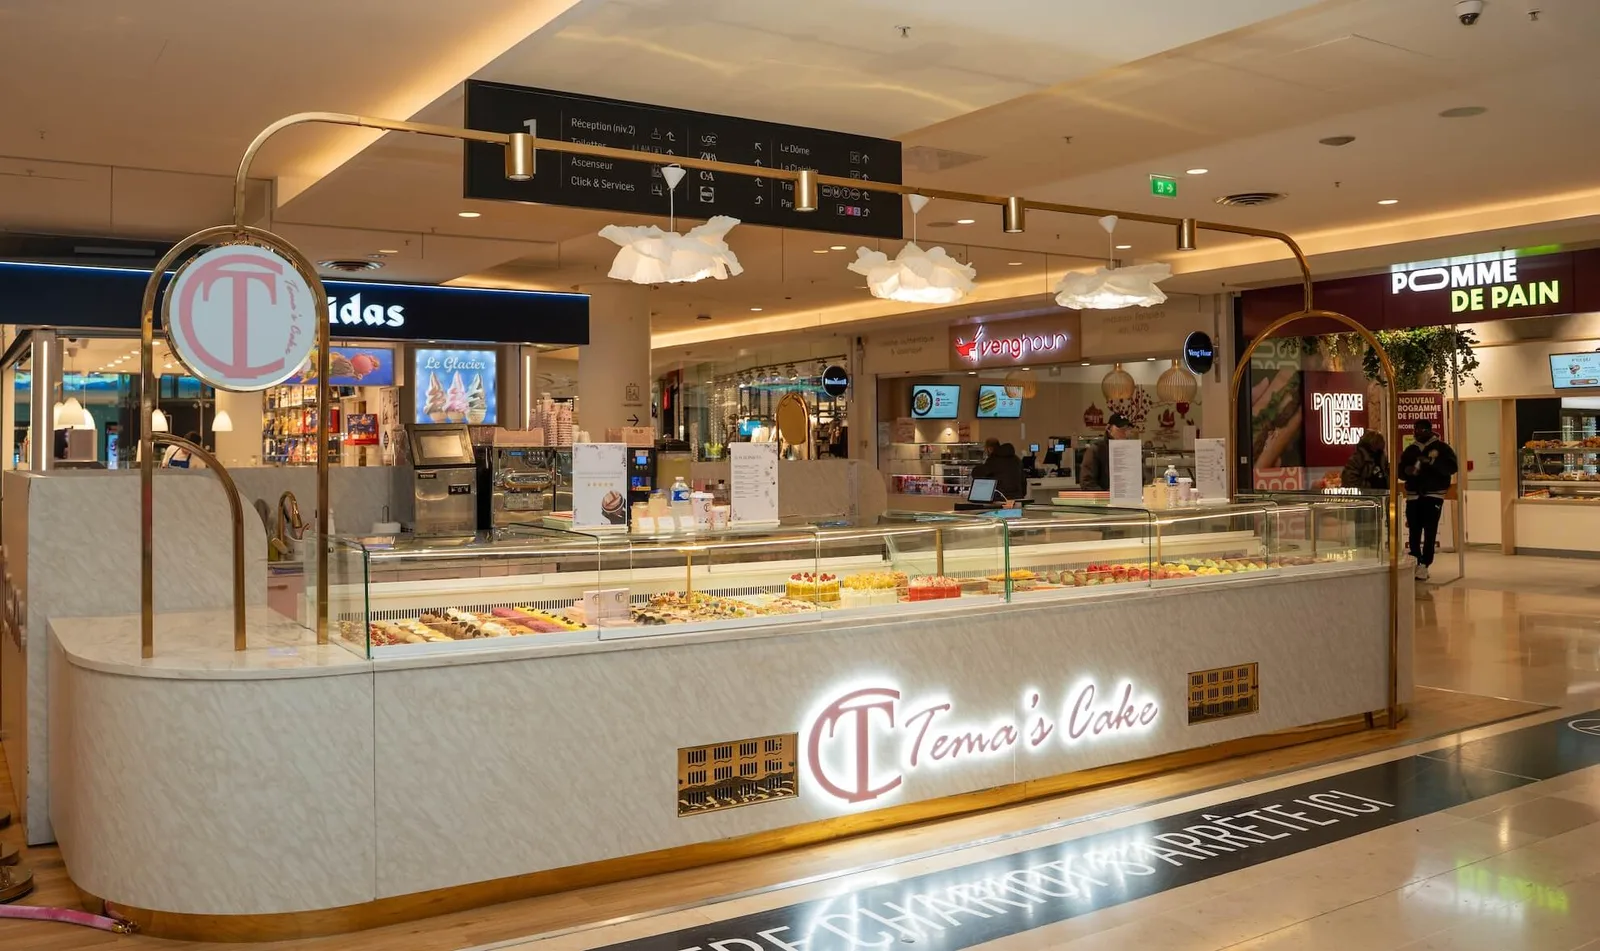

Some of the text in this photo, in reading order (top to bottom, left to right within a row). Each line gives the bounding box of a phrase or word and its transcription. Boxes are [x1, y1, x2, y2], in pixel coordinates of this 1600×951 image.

[571, 117, 636, 136] Réception (niv.2)
[780, 143, 810, 155] Le Dôme
[571, 157, 614, 170] Ascenseur
[571, 175, 635, 192] Click & Services
[1392, 259, 1518, 294] POMME
[1451, 280, 1559, 313] DE PAIN
[425, 356, 486, 373] Le Glacier
[1399, 396, 1435, 404] NOUVEAU
[1333, 411, 1350, 427] DE
[1397, 410, 1438, 420] DE FIDÉLITÉ
[905, 683, 1158, 767] Tema's Cake
[1292, 790, 1396, 819] ICI
